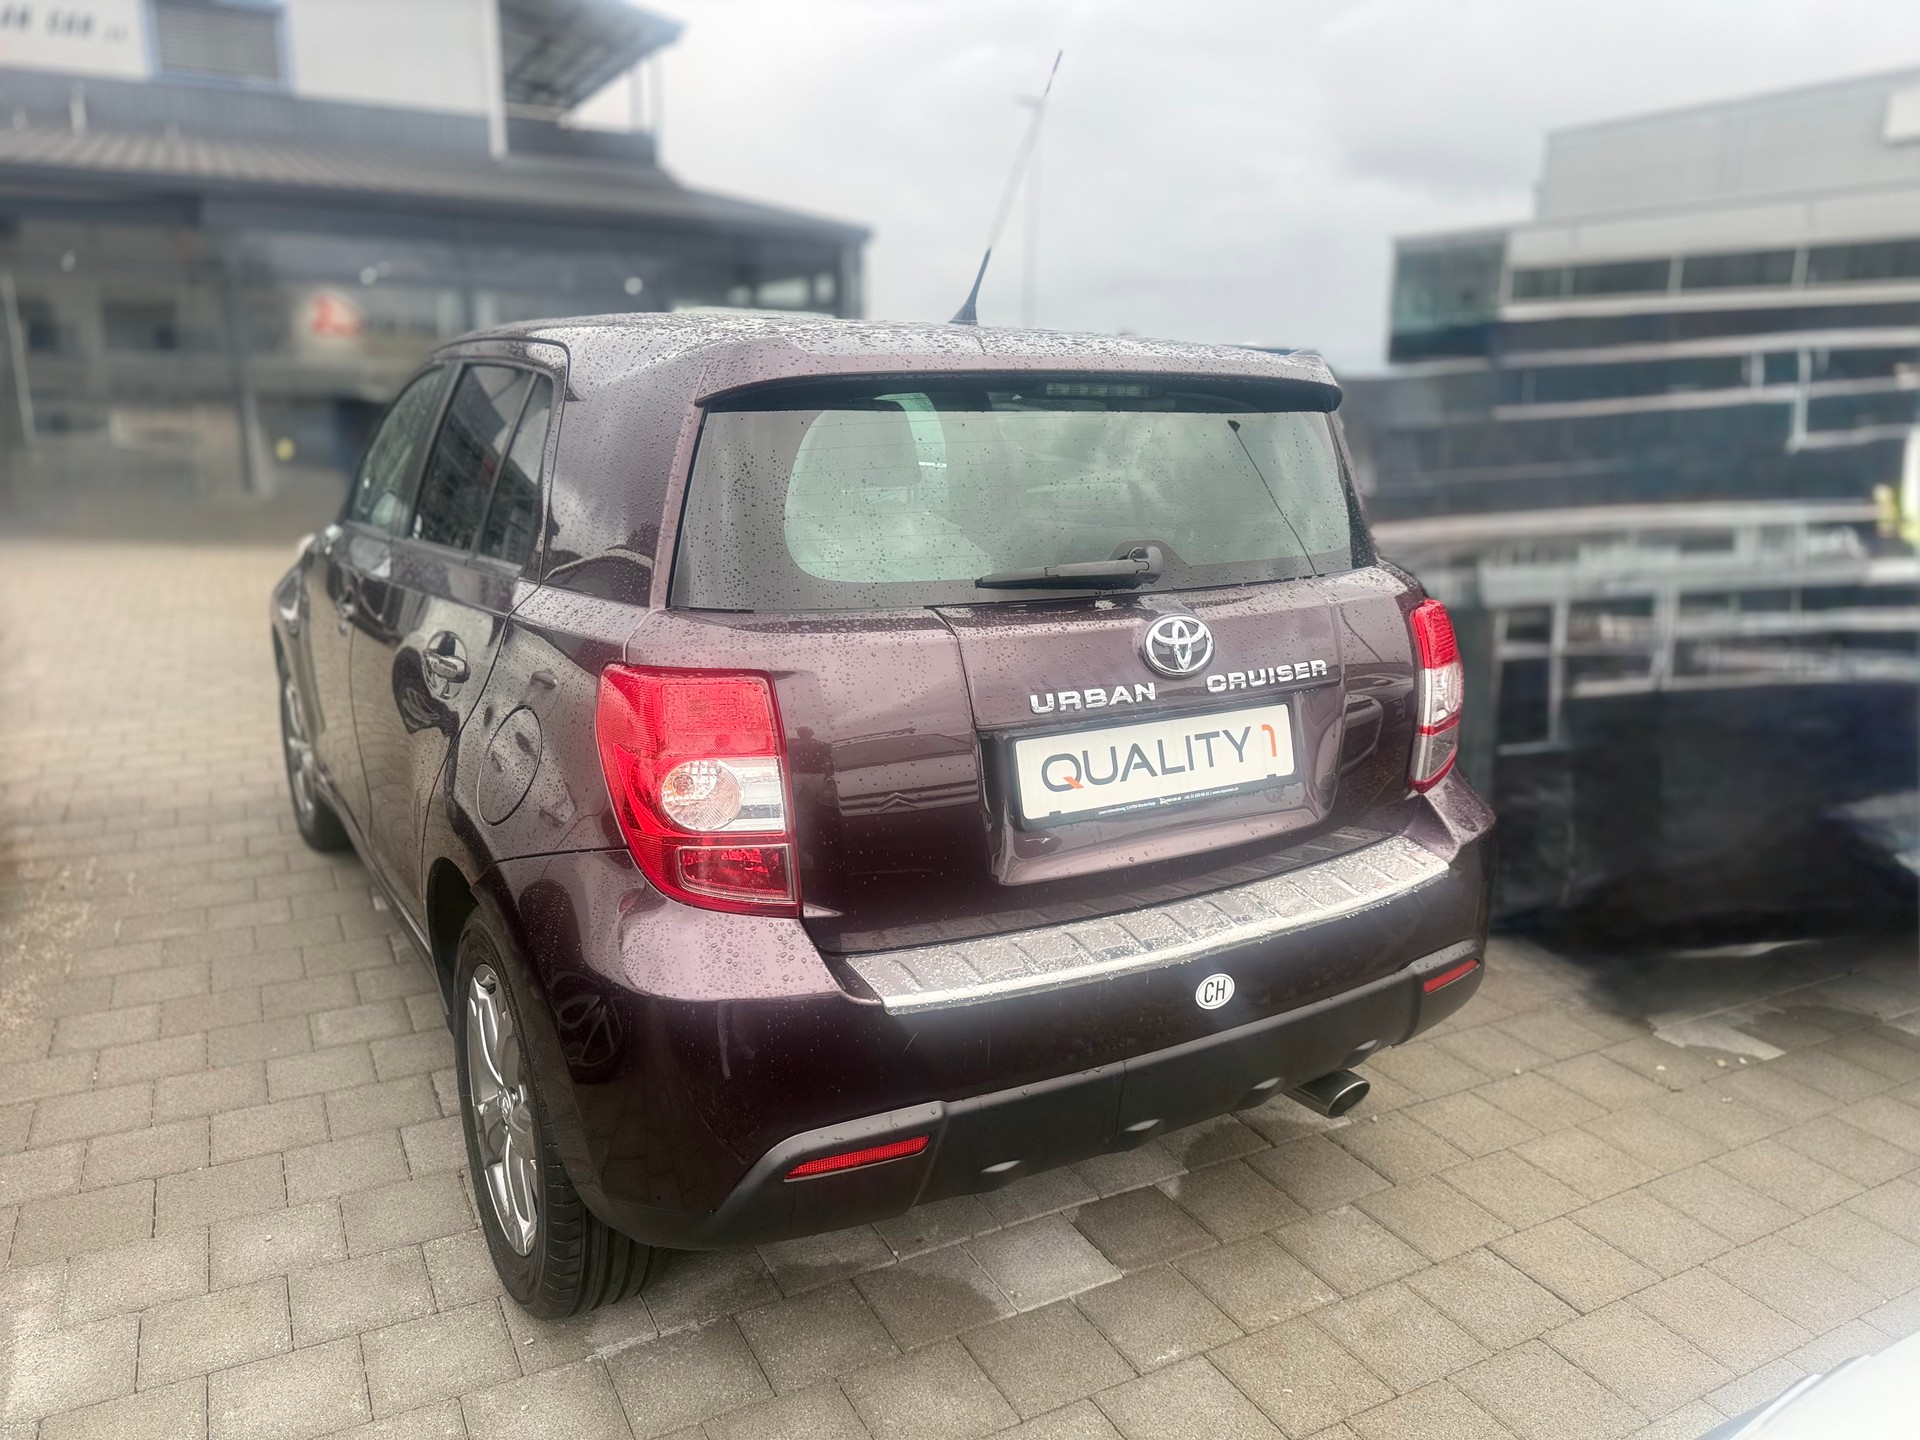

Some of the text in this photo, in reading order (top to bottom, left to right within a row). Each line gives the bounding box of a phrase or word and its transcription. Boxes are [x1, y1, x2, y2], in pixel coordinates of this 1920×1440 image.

[1029, 659, 1328, 714] URBAN CRUISER
[1041, 726, 1252, 793] QUALITY
[1204, 979, 1226, 1003] CH
